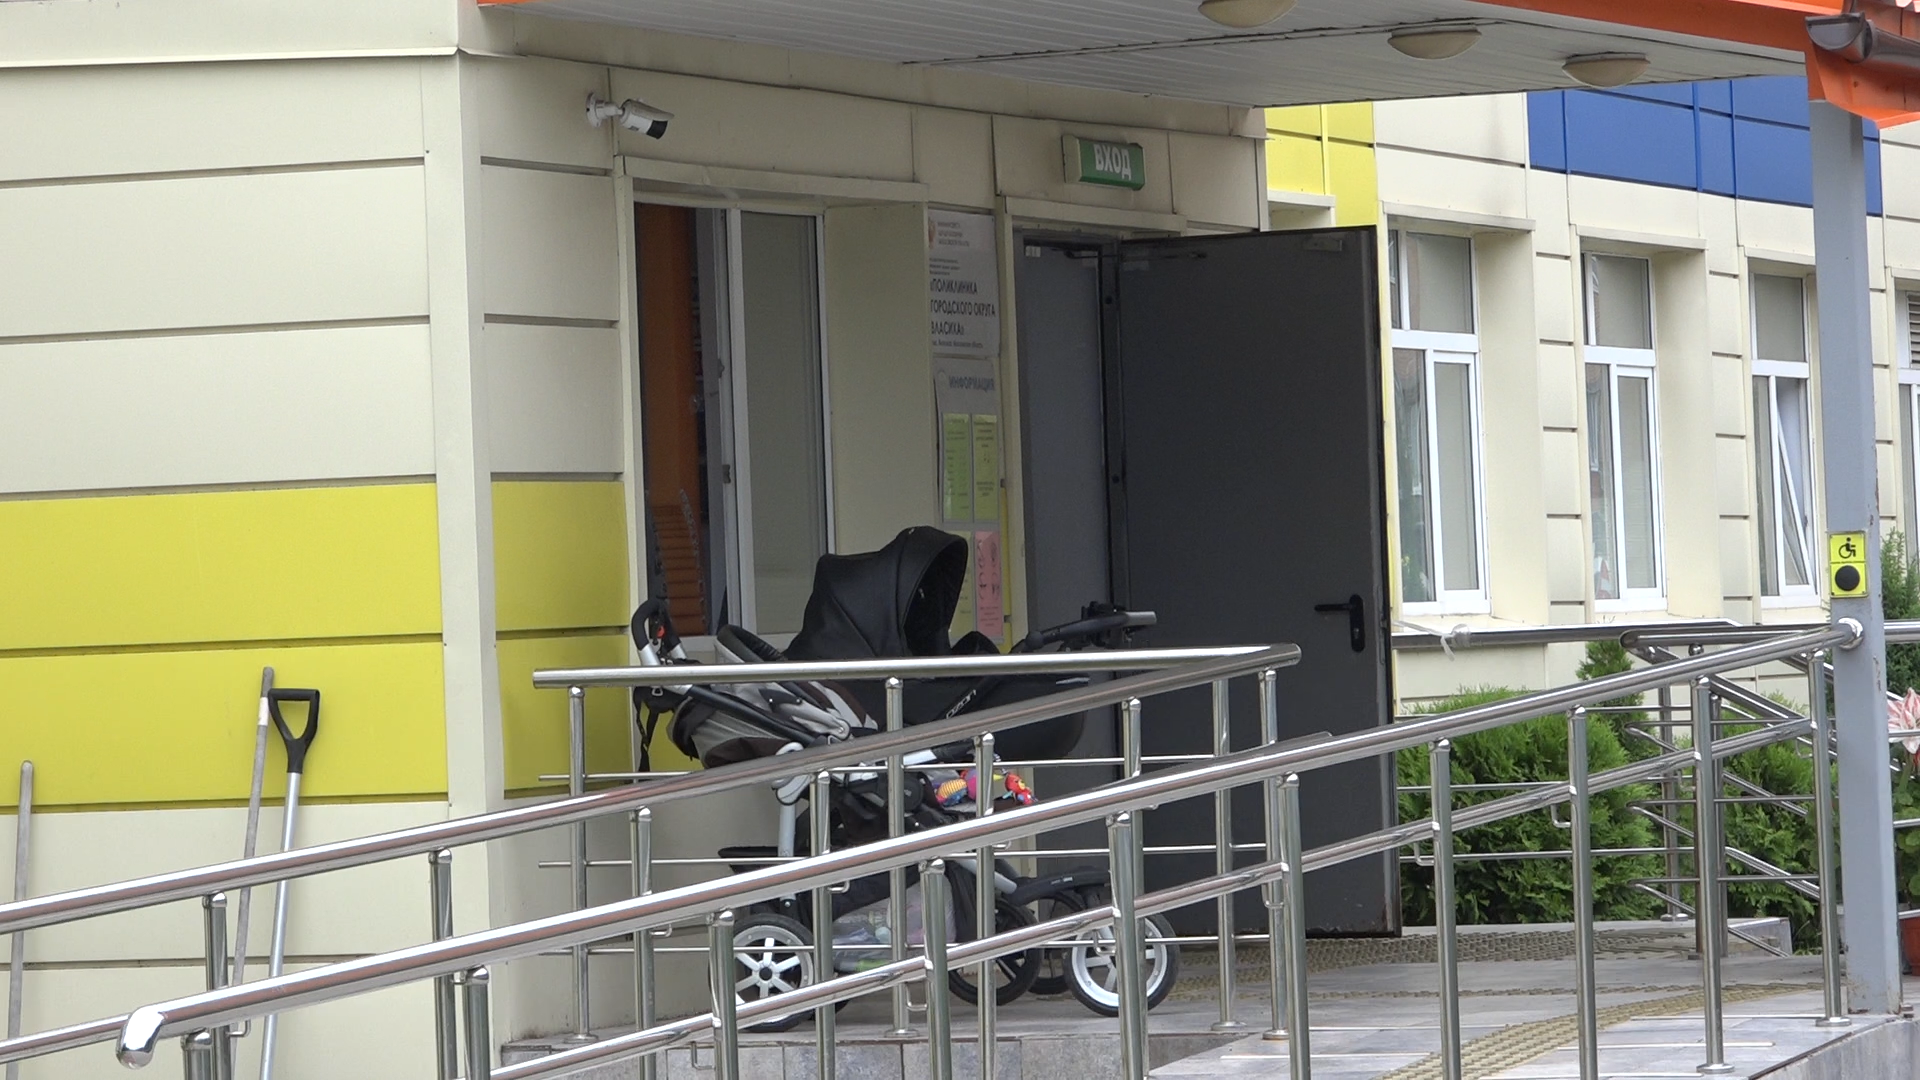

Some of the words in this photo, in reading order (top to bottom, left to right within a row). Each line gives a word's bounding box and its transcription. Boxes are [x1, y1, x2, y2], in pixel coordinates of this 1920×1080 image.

[1093, 143, 1131, 181] ВХОД
[930, 299, 973, 316] ГОРОДСКОГО
[974, 302, 996, 317] ОКРУГА
[949, 375, 995, 393] ИНФОРМАЦИЯ
